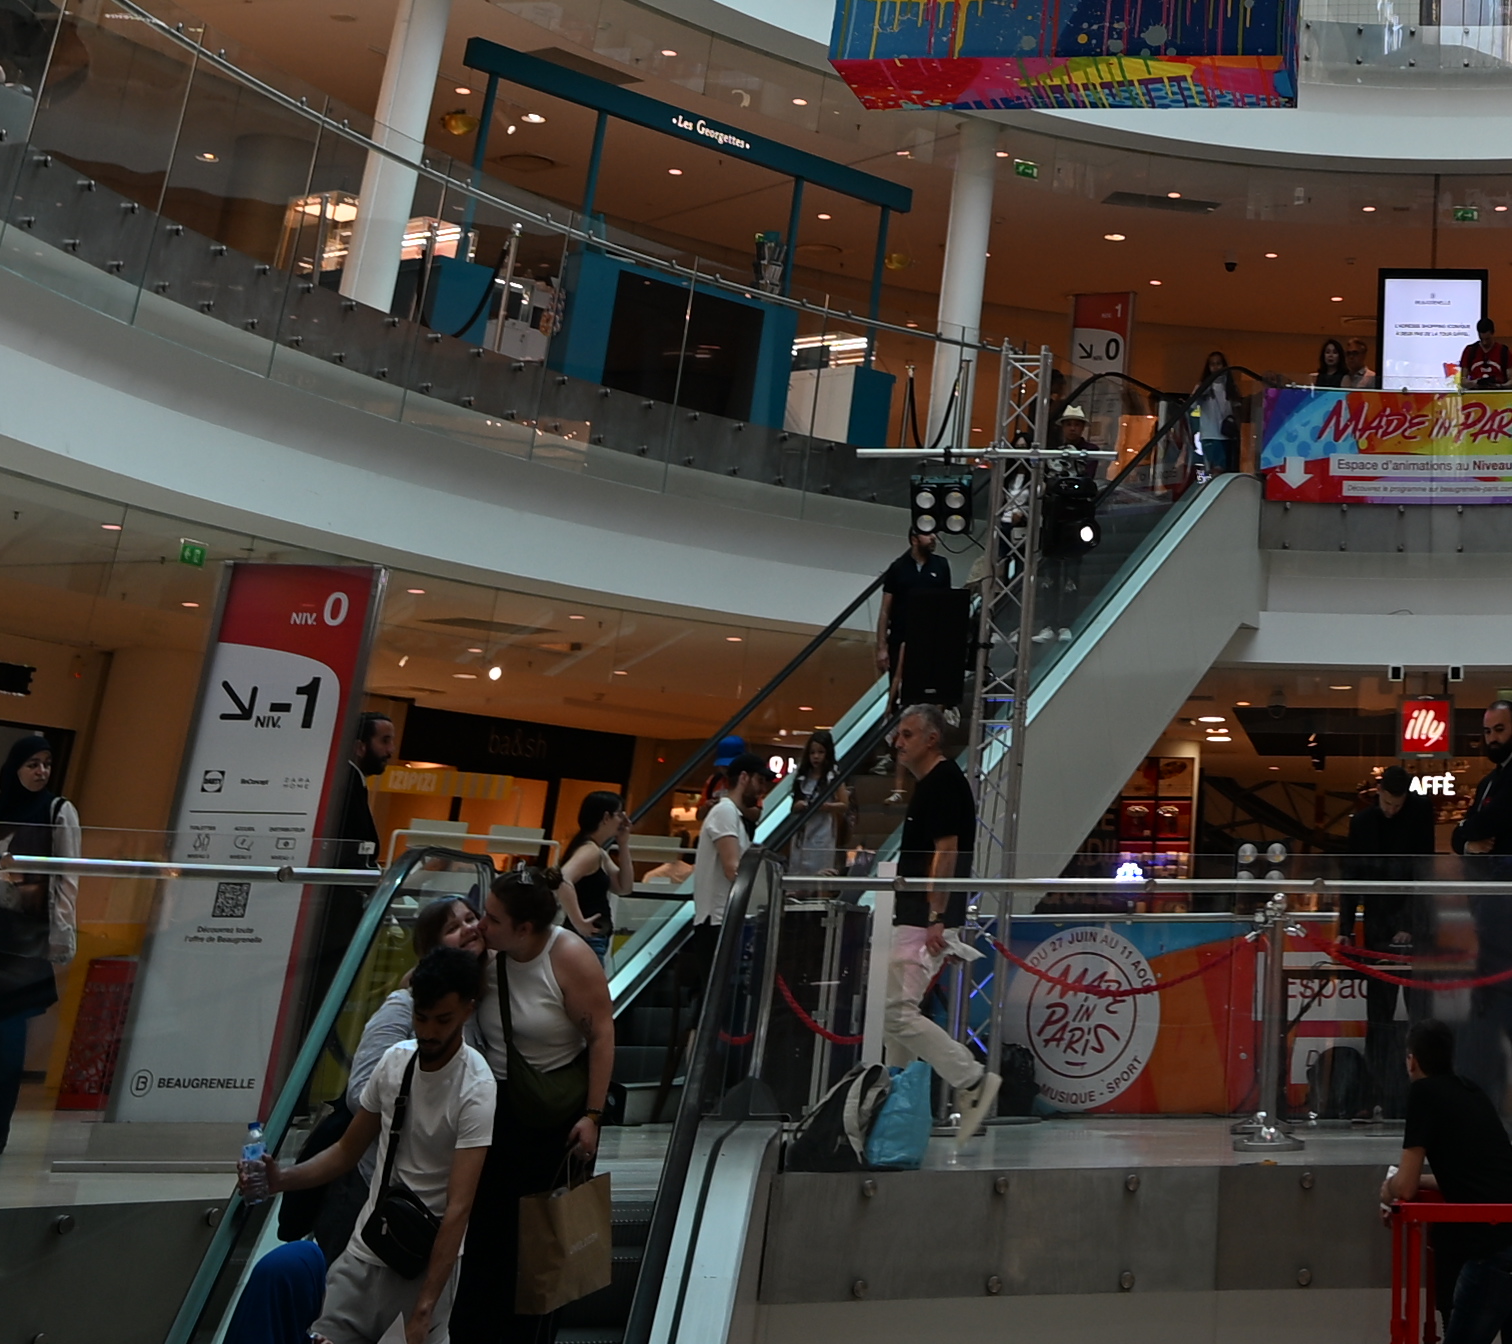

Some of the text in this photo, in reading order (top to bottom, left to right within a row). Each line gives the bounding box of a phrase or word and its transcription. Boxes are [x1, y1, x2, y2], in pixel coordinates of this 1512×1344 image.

[677, 114, 745, 149] Les Georgettes
[1115, 303, 1122, 318] 1
[1105, 338, 1120, 361] 0
[1316, 399, 1431, 443] MADE
[1337, 458, 1379, 472] Espace
[1381, 458, 1453, 471] d'animations
[1456, 462, 1469, 471] au
[1472, 459, 1512, 471] Niveau
[290, 591, 350, 627] NIV. 0
[254, 676, 322, 729] NIV. -1
[488, 726, 548, 760] ba&sh
[1404, 709, 1446, 747] illy
[388, 769, 438, 792] IZIPIZI
[235, 926, 254, 934] toute
[1029, 931, 1155, 996] DU 27 JUIN AU 11 AO
[1036, 1002, 1120, 1057] PARIS
[157, 1077, 256, 1090] BEAUGRENELLE
[1040, 1083, 1096, 1105] MUSIQUE
[1106, 1055, 1143, 1095] SPORT
